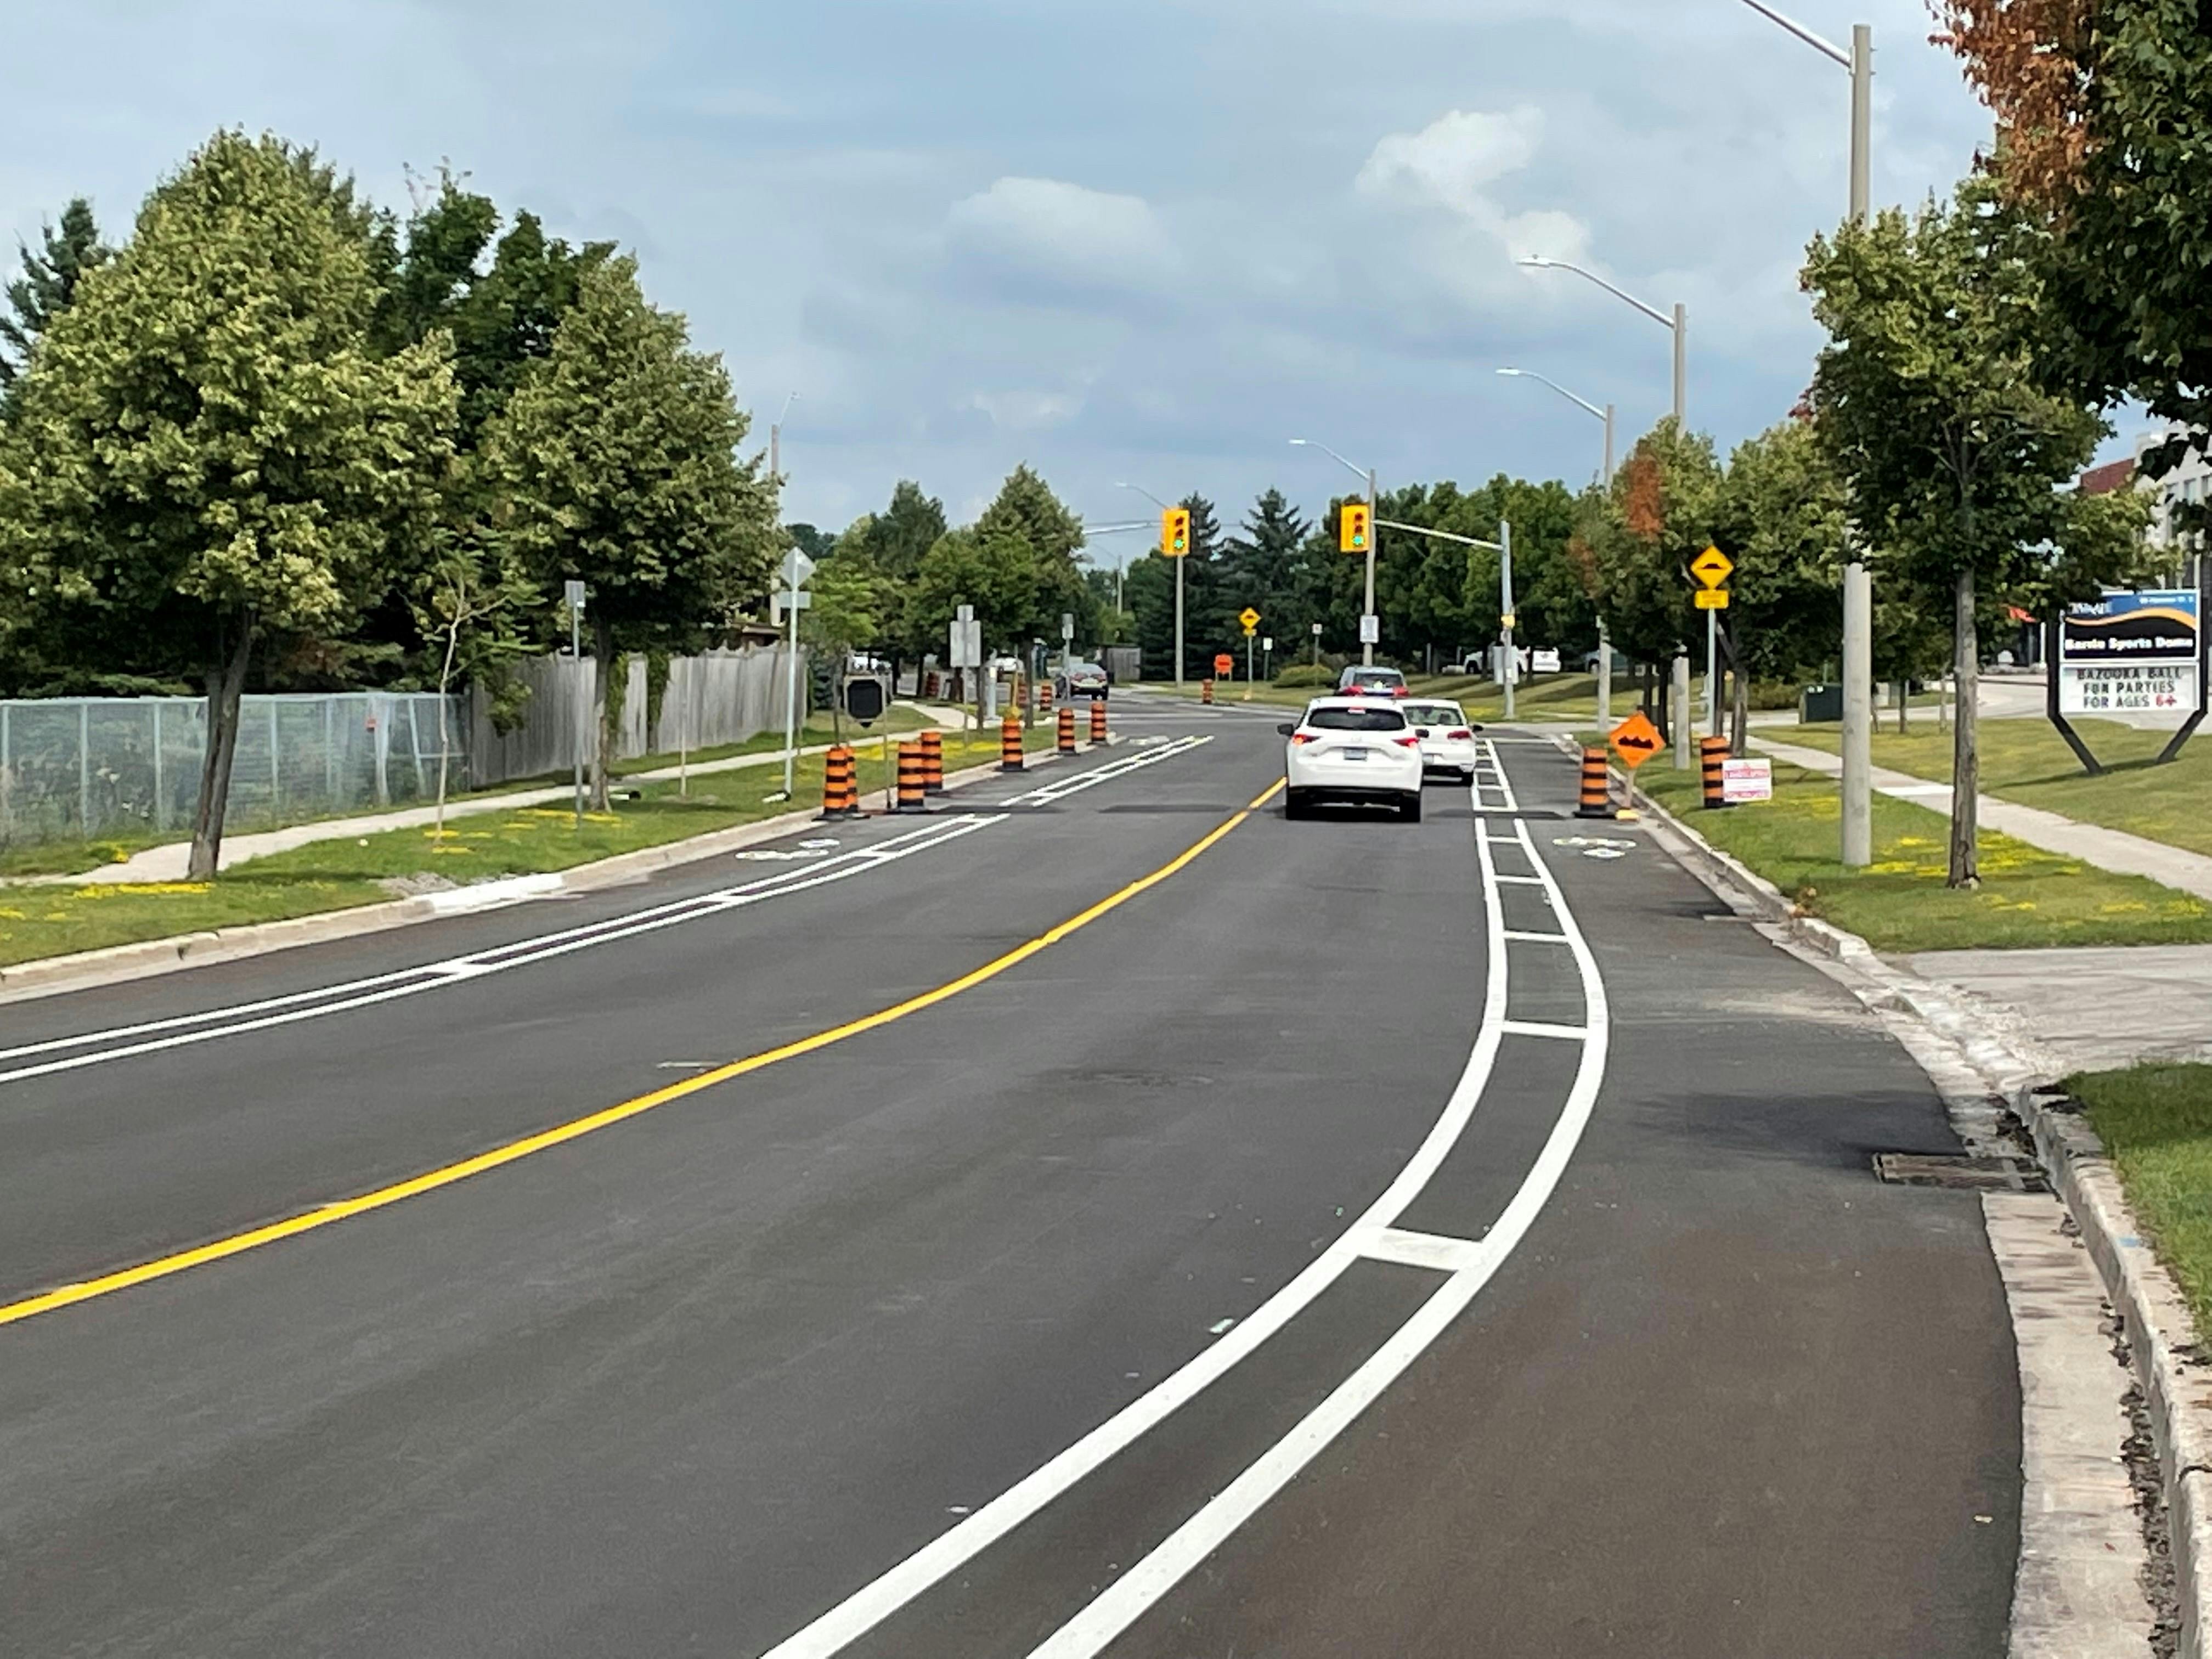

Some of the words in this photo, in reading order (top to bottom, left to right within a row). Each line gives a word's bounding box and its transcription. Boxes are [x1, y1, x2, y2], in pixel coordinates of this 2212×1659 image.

[2108, 637, 2153, 651] Sports
[2077, 668, 2141, 680] BAZOOKA
[2148, 668, 2181, 679] BALL
[2084, 683, 2109, 694] FUN
[2117, 681, 2175, 693] PARTIES
[2084, 696, 2109, 708] FOR
[2116, 695, 2150, 707] AGES
[2155, 695, 2177, 707] 6+
